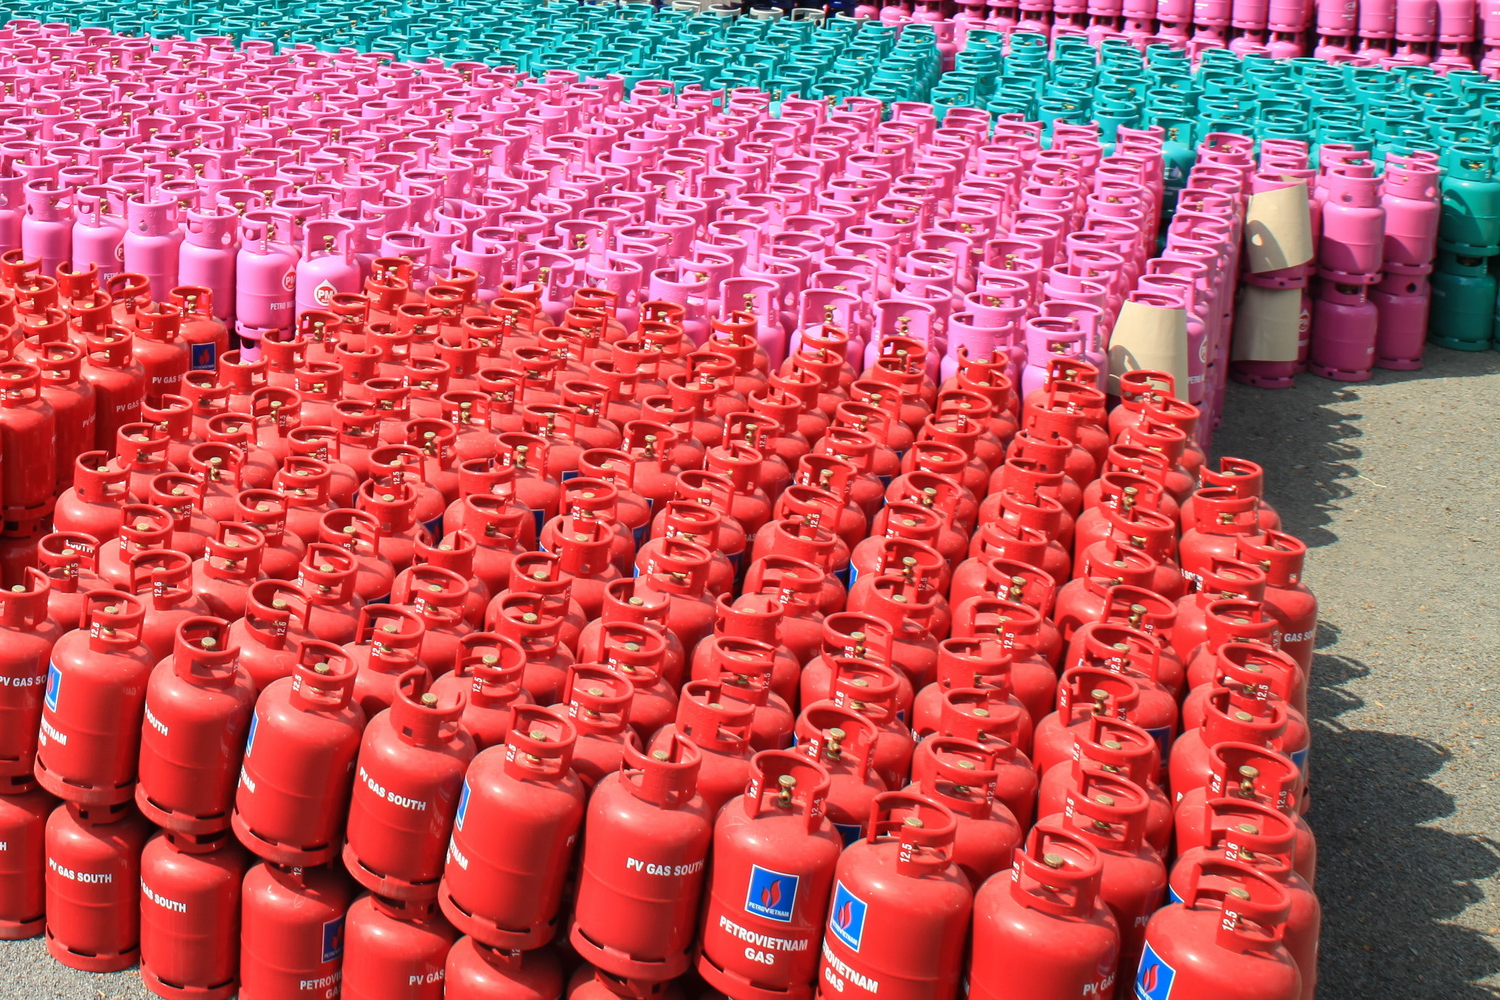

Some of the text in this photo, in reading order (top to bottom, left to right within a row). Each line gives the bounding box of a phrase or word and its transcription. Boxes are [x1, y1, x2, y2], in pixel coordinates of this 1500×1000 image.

[317, 289, 334, 299] PM
[270, 302, 285, 310] PETRO
[152, 376, 161, 384] PV
[116, 402, 138, 413] PV GAS
[1109, 494, 1118, 509] 12.4
[573, 506, 581, 520] 12.4
[810, 513, 820, 528] 12.5
[154, 581, 162, 597] 12.6
[415, 598, 425, 613] 12.5
[91, 622, 100, 638] 12.6
[278, 621, 286, 637] 12.6
[1004, 632, 1015, 648] 12.5
[1284, 632, 1302, 643] GAS
[372, 641, 382, 657] 12.5
[608, 658, 617, 671] 2.5
[1110, 656, 1122, 674] 12.5
[13, 677, 32, 687] GAS
[293, 674, 302, 691] 12.5
[472, 677, 483, 693] 12.5
[835, 691, 845, 707] 12.6
[1257, 684, 1269, 701] 12.5
[569, 700, 578, 718] 12.5
[147, 709, 168, 736] SOUTH
[359, 766, 426, 811] PV GAS SOUTH
[749, 779, 759, 799] 12.4
[810, 798, 821, 818] 12.4
[900, 843, 912, 863] 12.5
[1225, 841, 1239, 862] 12.6
[49, 858, 112, 884] PV GAS SOUTH
[626, 858, 704, 876] PV GAS SOUTH
[155, 893, 187, 913] SOUTH
[749, 901, 790, 918] PETROVIETNAM
[1222, 908, 1238, 932] 12.5
[719, 915, 808, 951] PETROVIETNAM
[744, 947, 775, 965] GAS
[409, 970, 444, 986] PV GAS
[824, 966, 844, 993] GAS
[1083, 975, 1115, 997] PV GAS
[326, 986, 342, 999] GA
